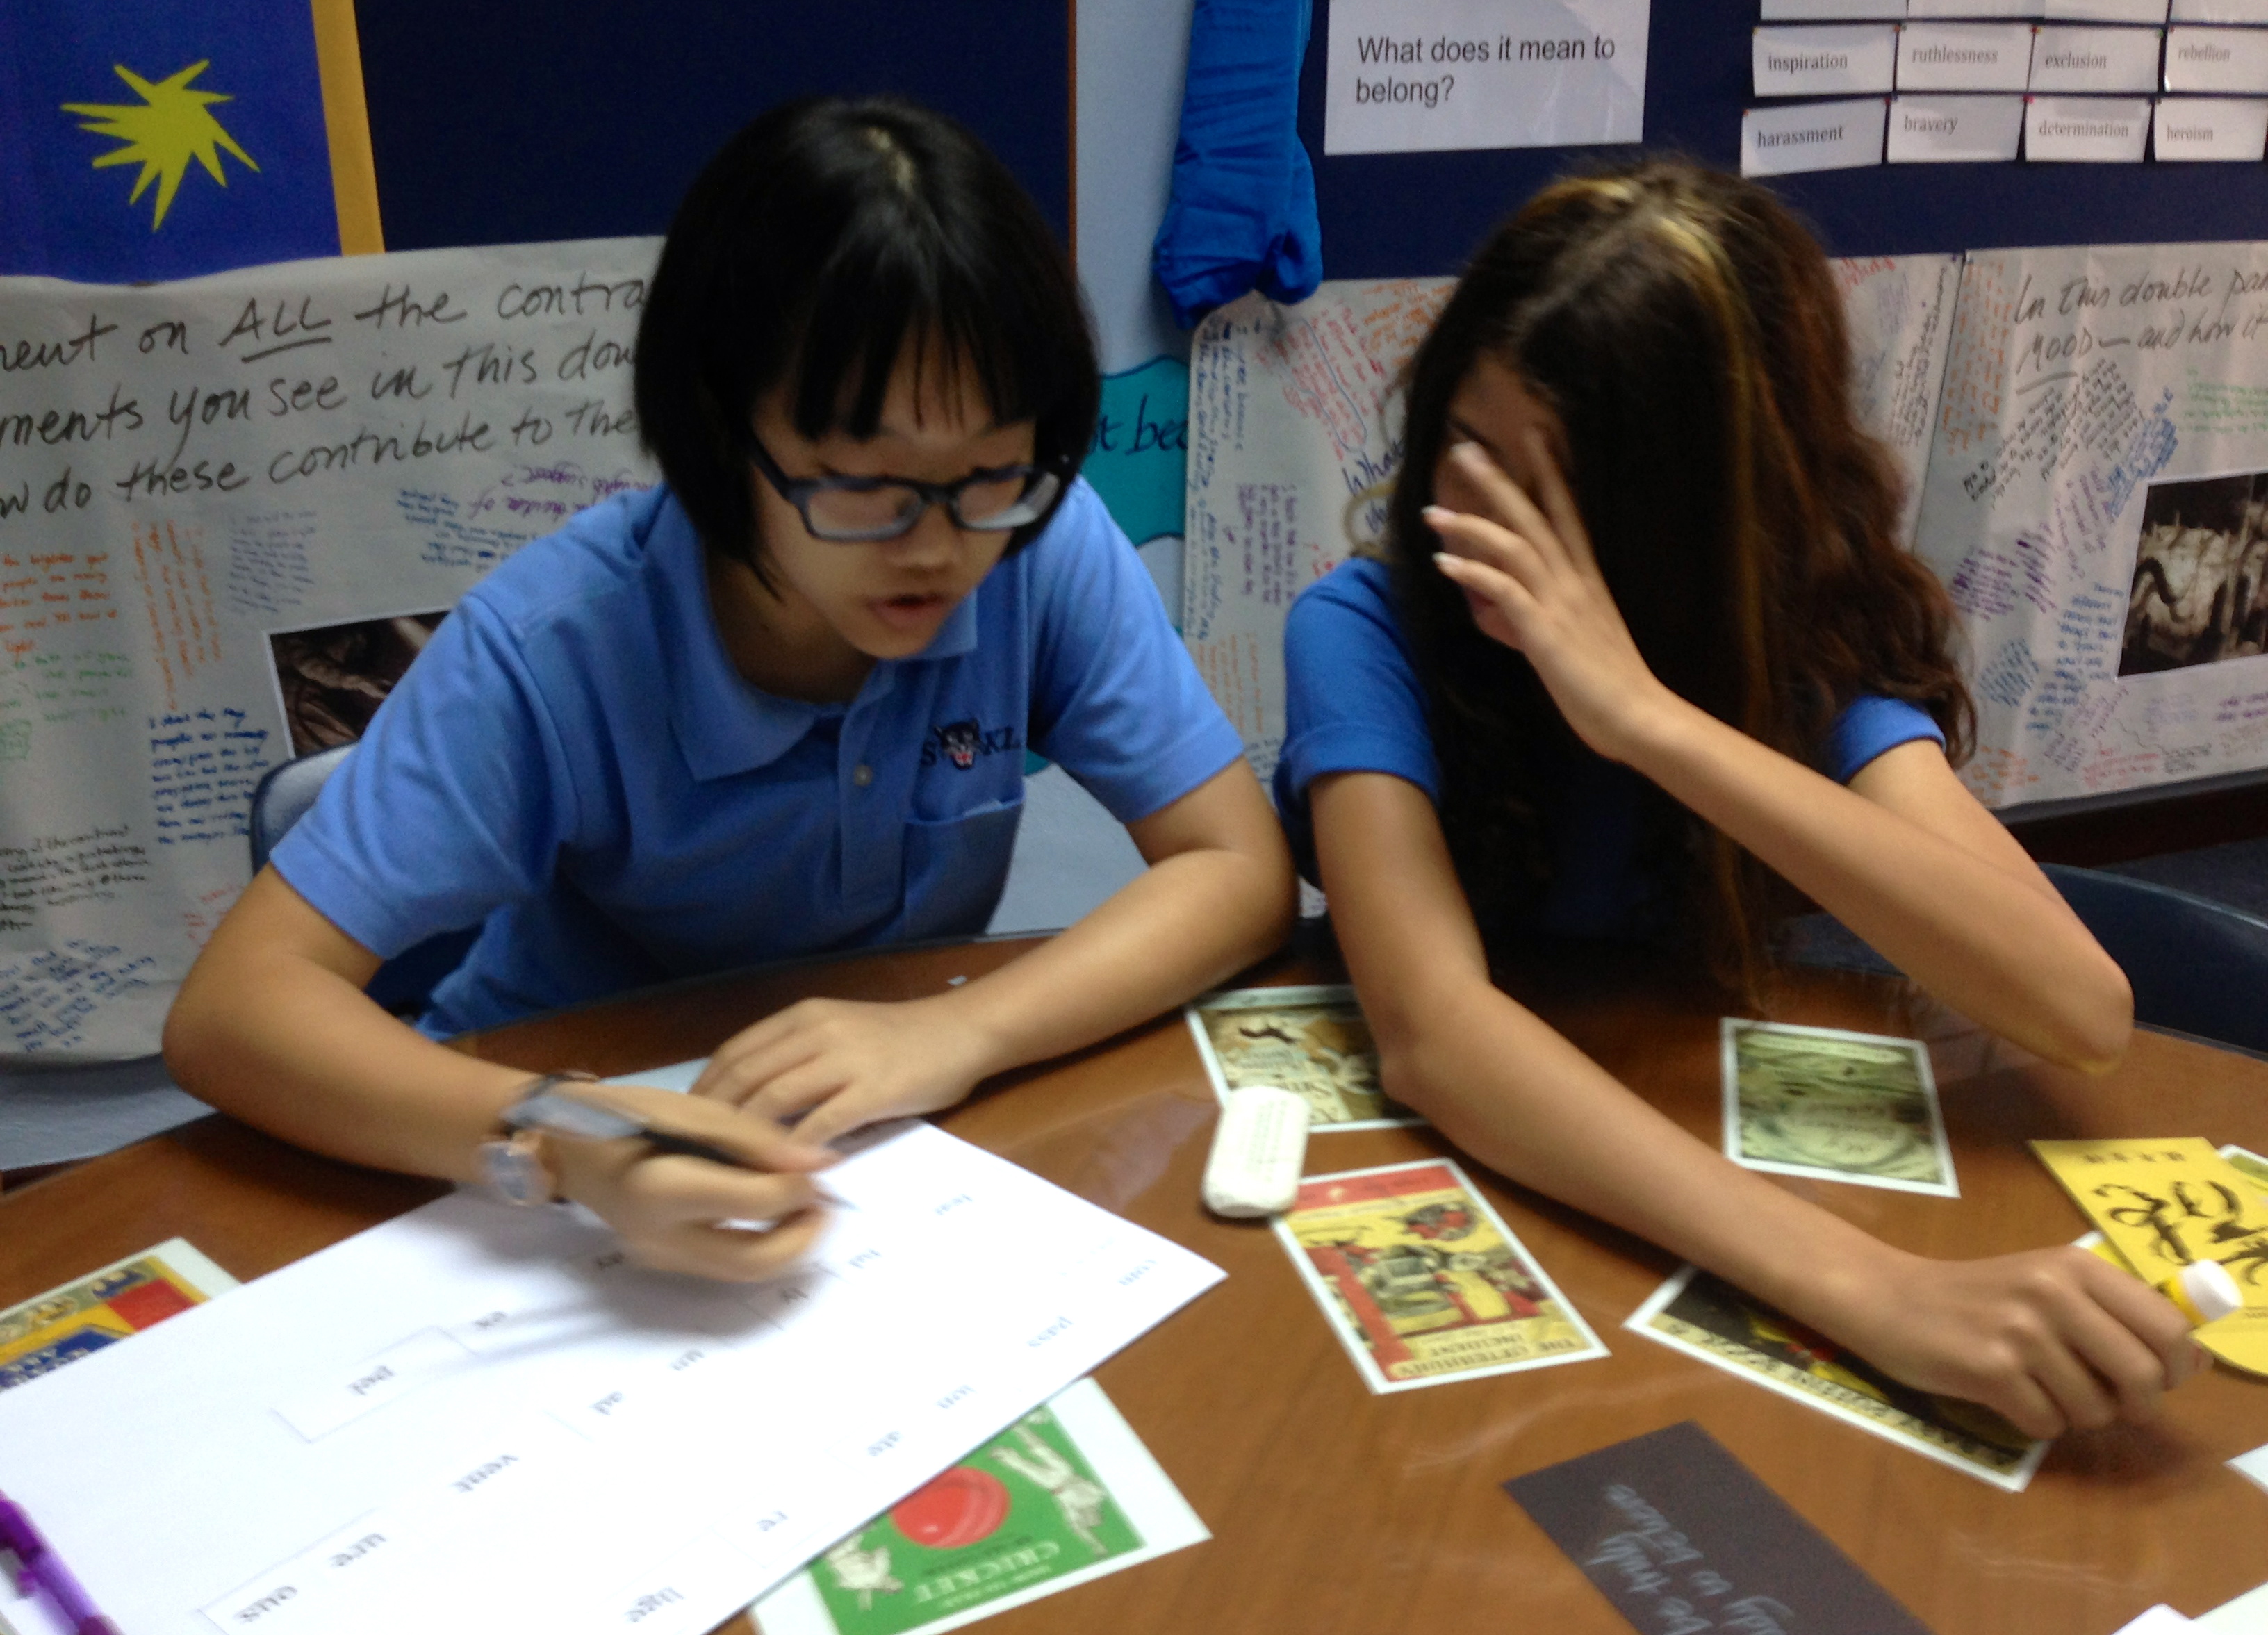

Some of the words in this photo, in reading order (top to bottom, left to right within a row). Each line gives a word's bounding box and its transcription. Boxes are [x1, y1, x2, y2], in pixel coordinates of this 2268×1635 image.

[1358, 36, 1423, 64] What
[1431, 35, 1490, 63] does
[1497, 34, 1511, 61] it
[1519, 38, 1586, 61] mean
[1594, 35, 1616, 61] to
[1768, 54, 1848, 72] inspiration
[1912, 46, 1998, 65] ruthlessness
[2044, 52, 2107, 69] exclusion
[2178, 44, 2232, 63] rebellion
[1355, 74, 1455, 108] belong?
[1757, 126, 1844, 149] harassment
[1904, 115, 1959, 135] bravery
[2038, 120, 2130, 139] determination
[2166, 126, 2214, 142] heroism
[2120, 266, 2212, 307] double
[138, 320, 188, 356] on
[217, 297, 332, 346] ALL
[354, 285, 466, 327] the
[2137, 309, 2186, 350] and
[168, 384, 253, 471] you
[270, 373, 347, 411] see
[371, 350, 434, 400] in
[443, 341, 537, 388] this
[44, 465, 92, 513] do
[115, 455, 249, 503] these
[268, 417, 495, 479] contribute
[511, 411, 552, 446] to
[1027, 1316, 1074, 1349] pass
[329, 1533, 387, 1566] ure
[913, 1540, 1060, 1603] CRICKET
[236, 1586, 298, 1622] ous
